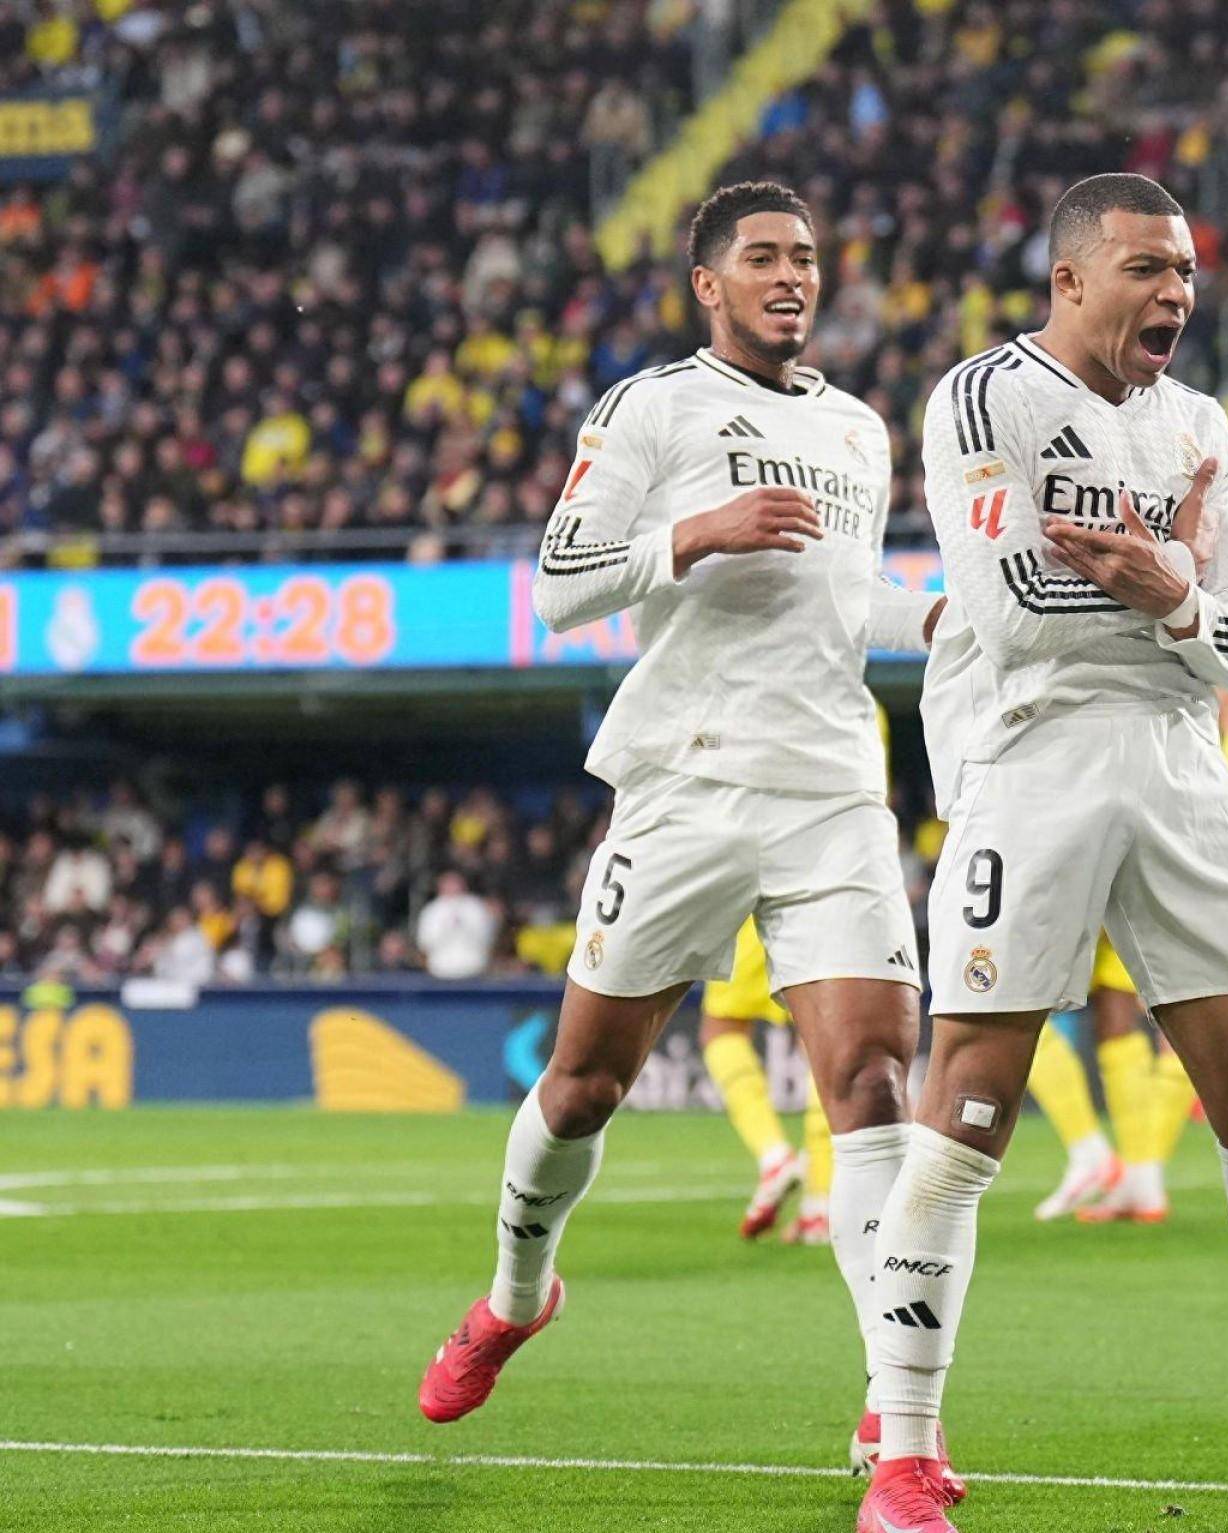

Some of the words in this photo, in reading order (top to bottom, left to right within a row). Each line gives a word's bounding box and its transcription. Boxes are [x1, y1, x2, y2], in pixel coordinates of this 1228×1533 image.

[727, 451, 873, 514] Emirates
[1043, 474, 1177, 526] Emrat
[814, 498, 861, 540] ETTER
[131, 572, 395, 667] 22:28
[596, 852, 632, 926] 5
[963, 848, 1004, 929] 9
[883, 1255, 955, 1278] RMCF
